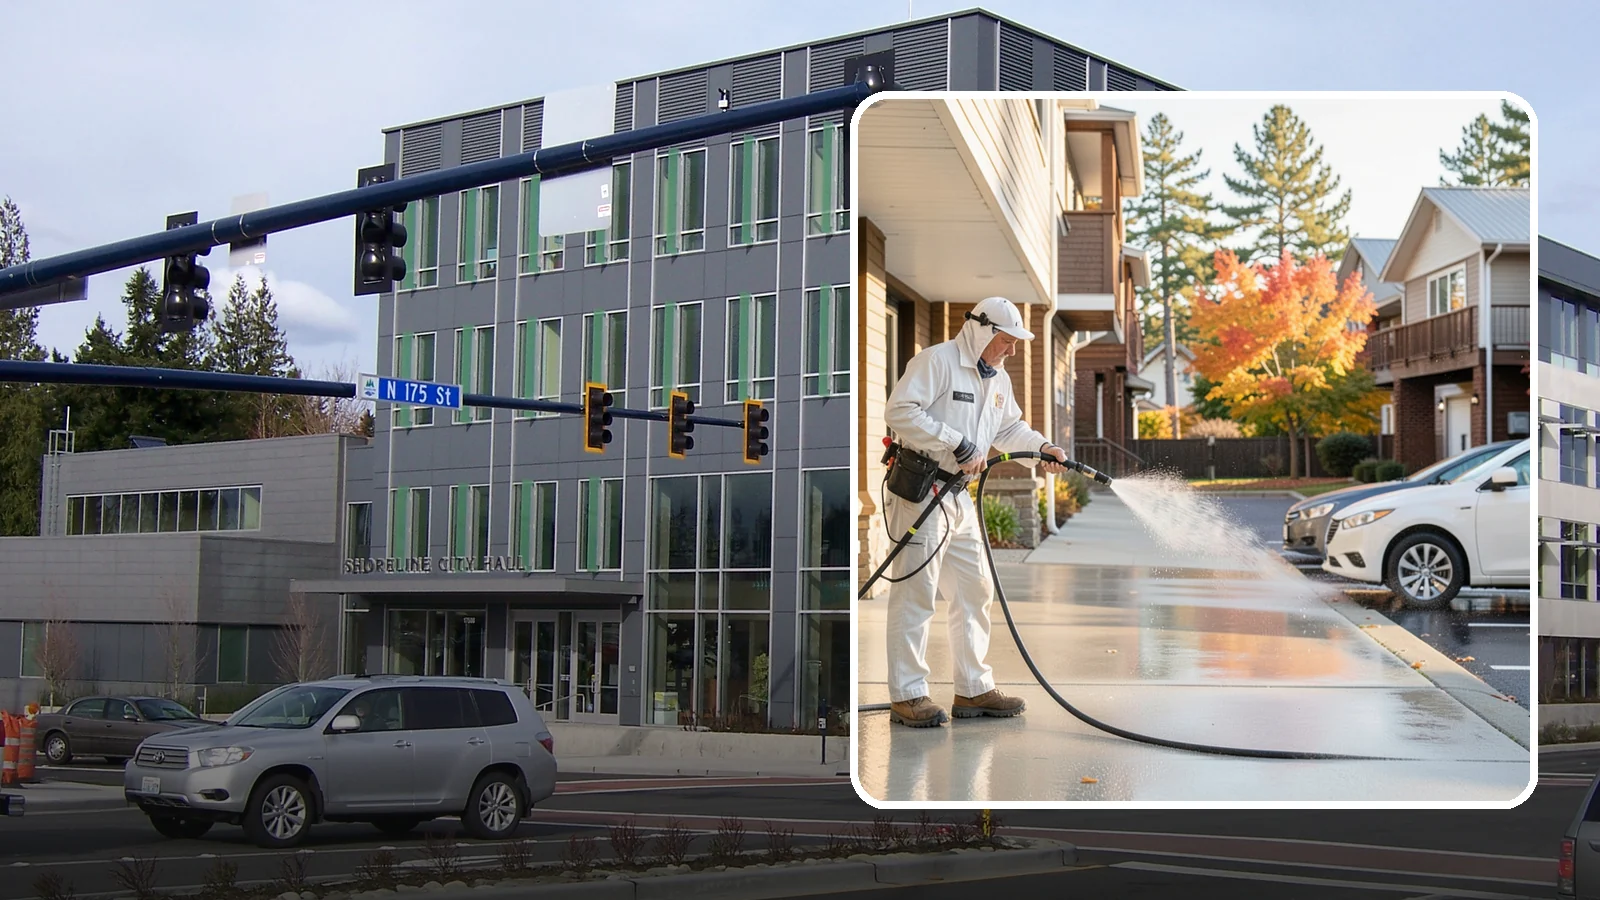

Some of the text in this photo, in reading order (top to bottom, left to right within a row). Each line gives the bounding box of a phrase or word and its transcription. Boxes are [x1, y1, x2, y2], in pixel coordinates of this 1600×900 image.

[387, 380, 451, 406] N 175 St
[344, 555, 526, 574] SHORELINE CITY HALL
